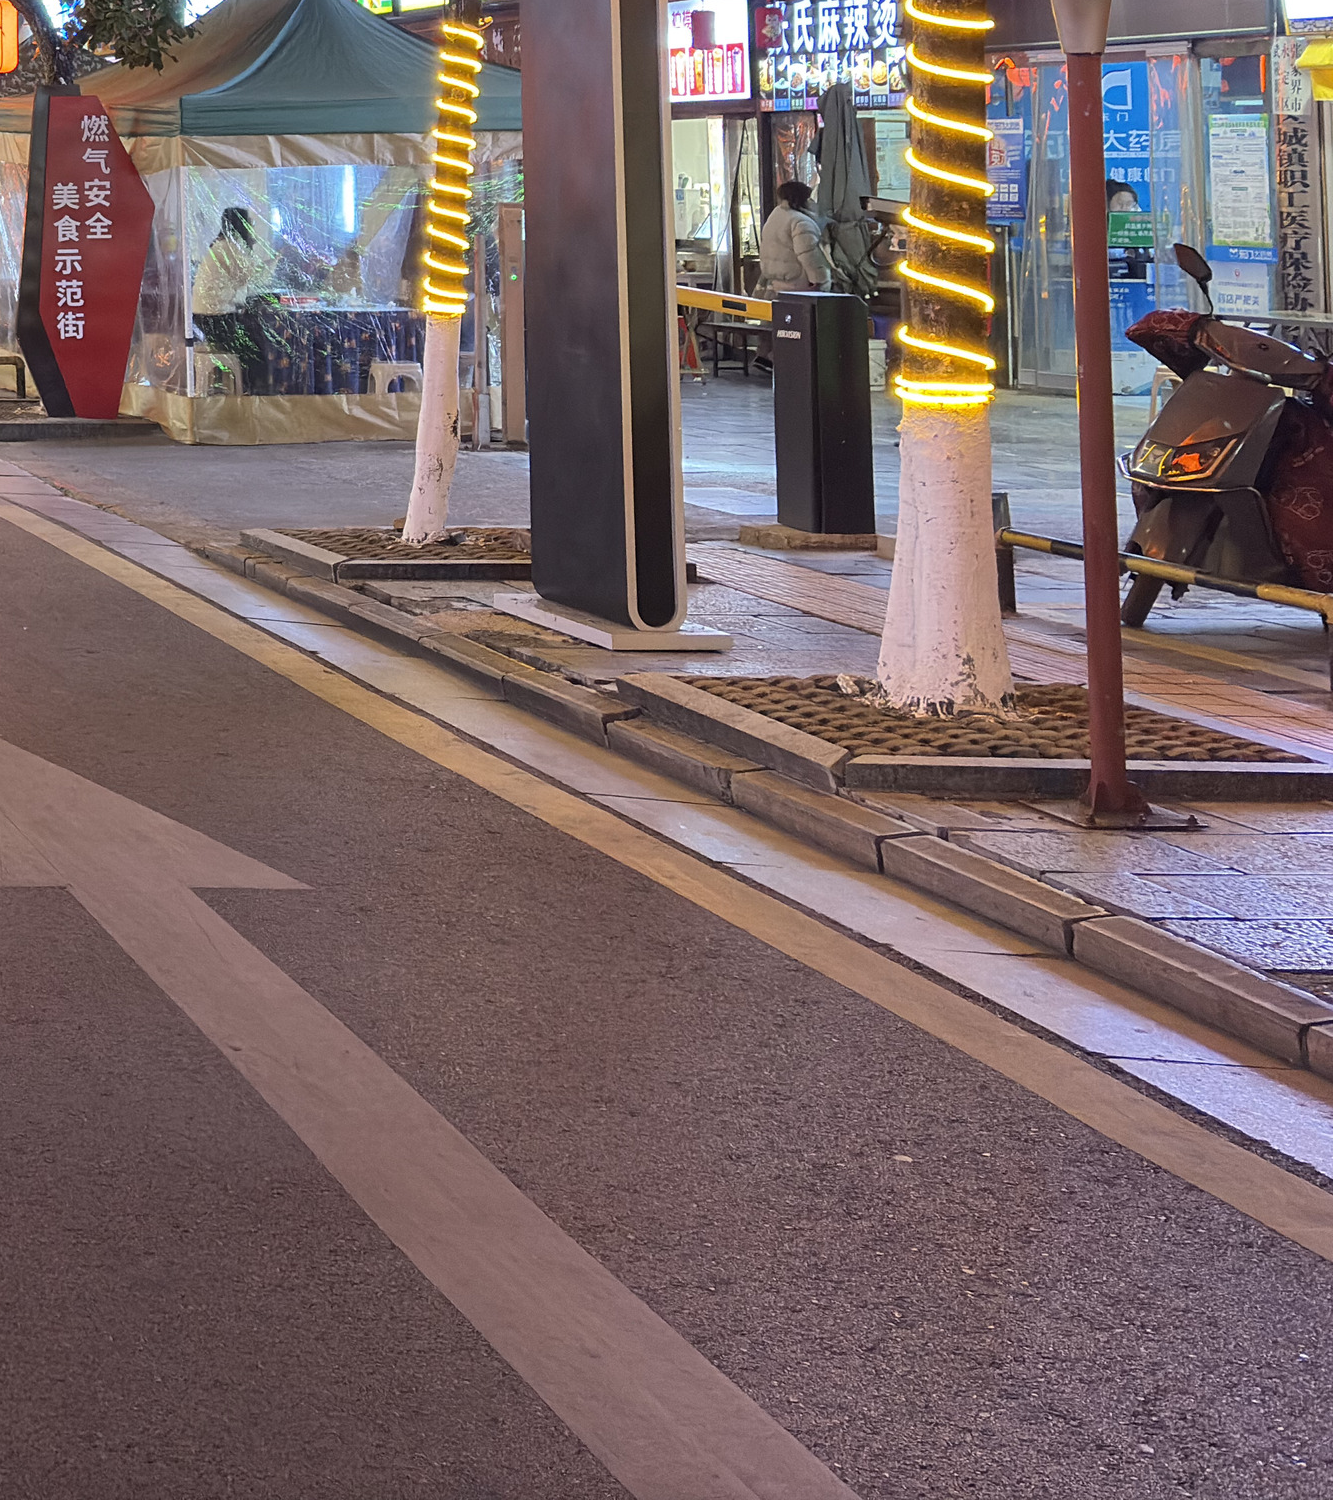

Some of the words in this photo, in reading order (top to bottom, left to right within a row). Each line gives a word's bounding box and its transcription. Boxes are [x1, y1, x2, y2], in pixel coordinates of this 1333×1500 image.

[80, 114, 112, 240] 燃气安全
[52, 182, 86, 340] 美食示范街
